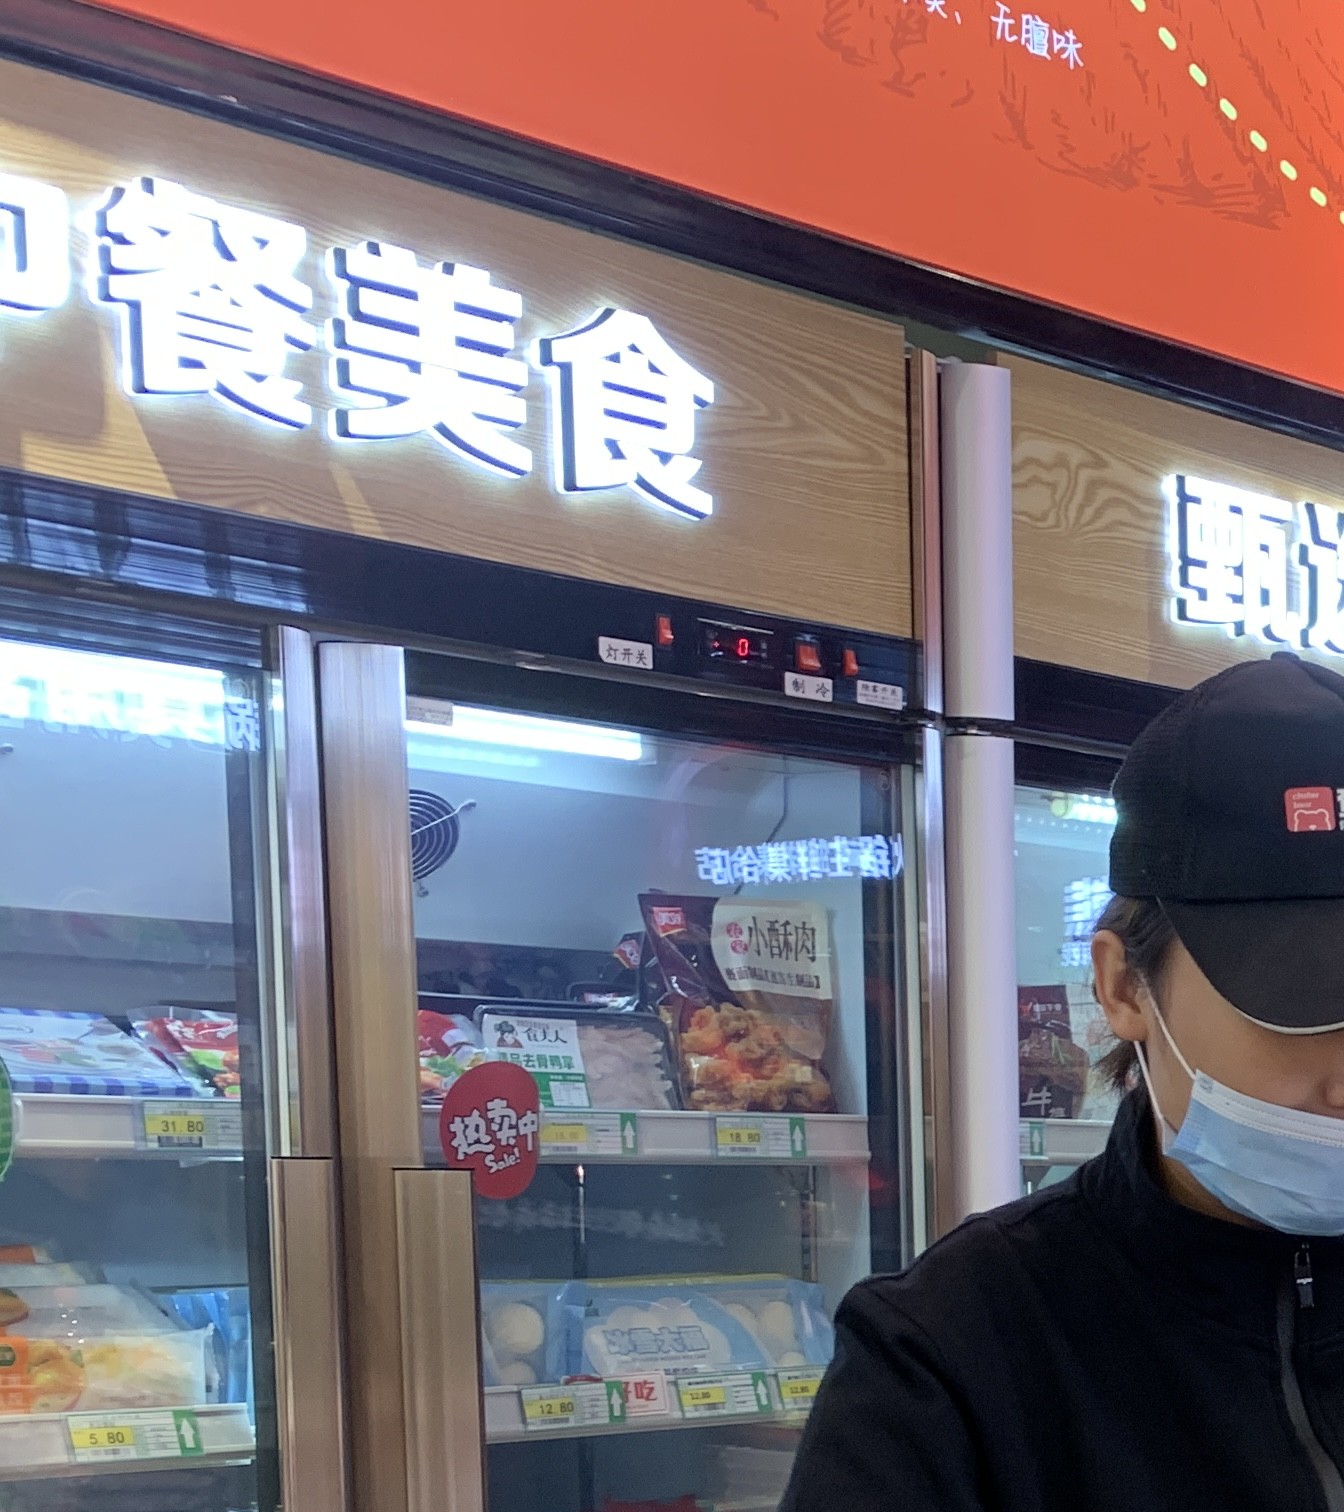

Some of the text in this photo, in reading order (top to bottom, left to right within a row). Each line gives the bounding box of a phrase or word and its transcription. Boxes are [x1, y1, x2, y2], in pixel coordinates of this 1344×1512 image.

[605, 643, 648, 667] 灯开关
[791, 677, 832, 699] 制冷
[747, 915, 816, 963] 小酥肉
[448, 1097, 540, 1162] 热卖中
[484, 1146, 522, 1174] Sale!
